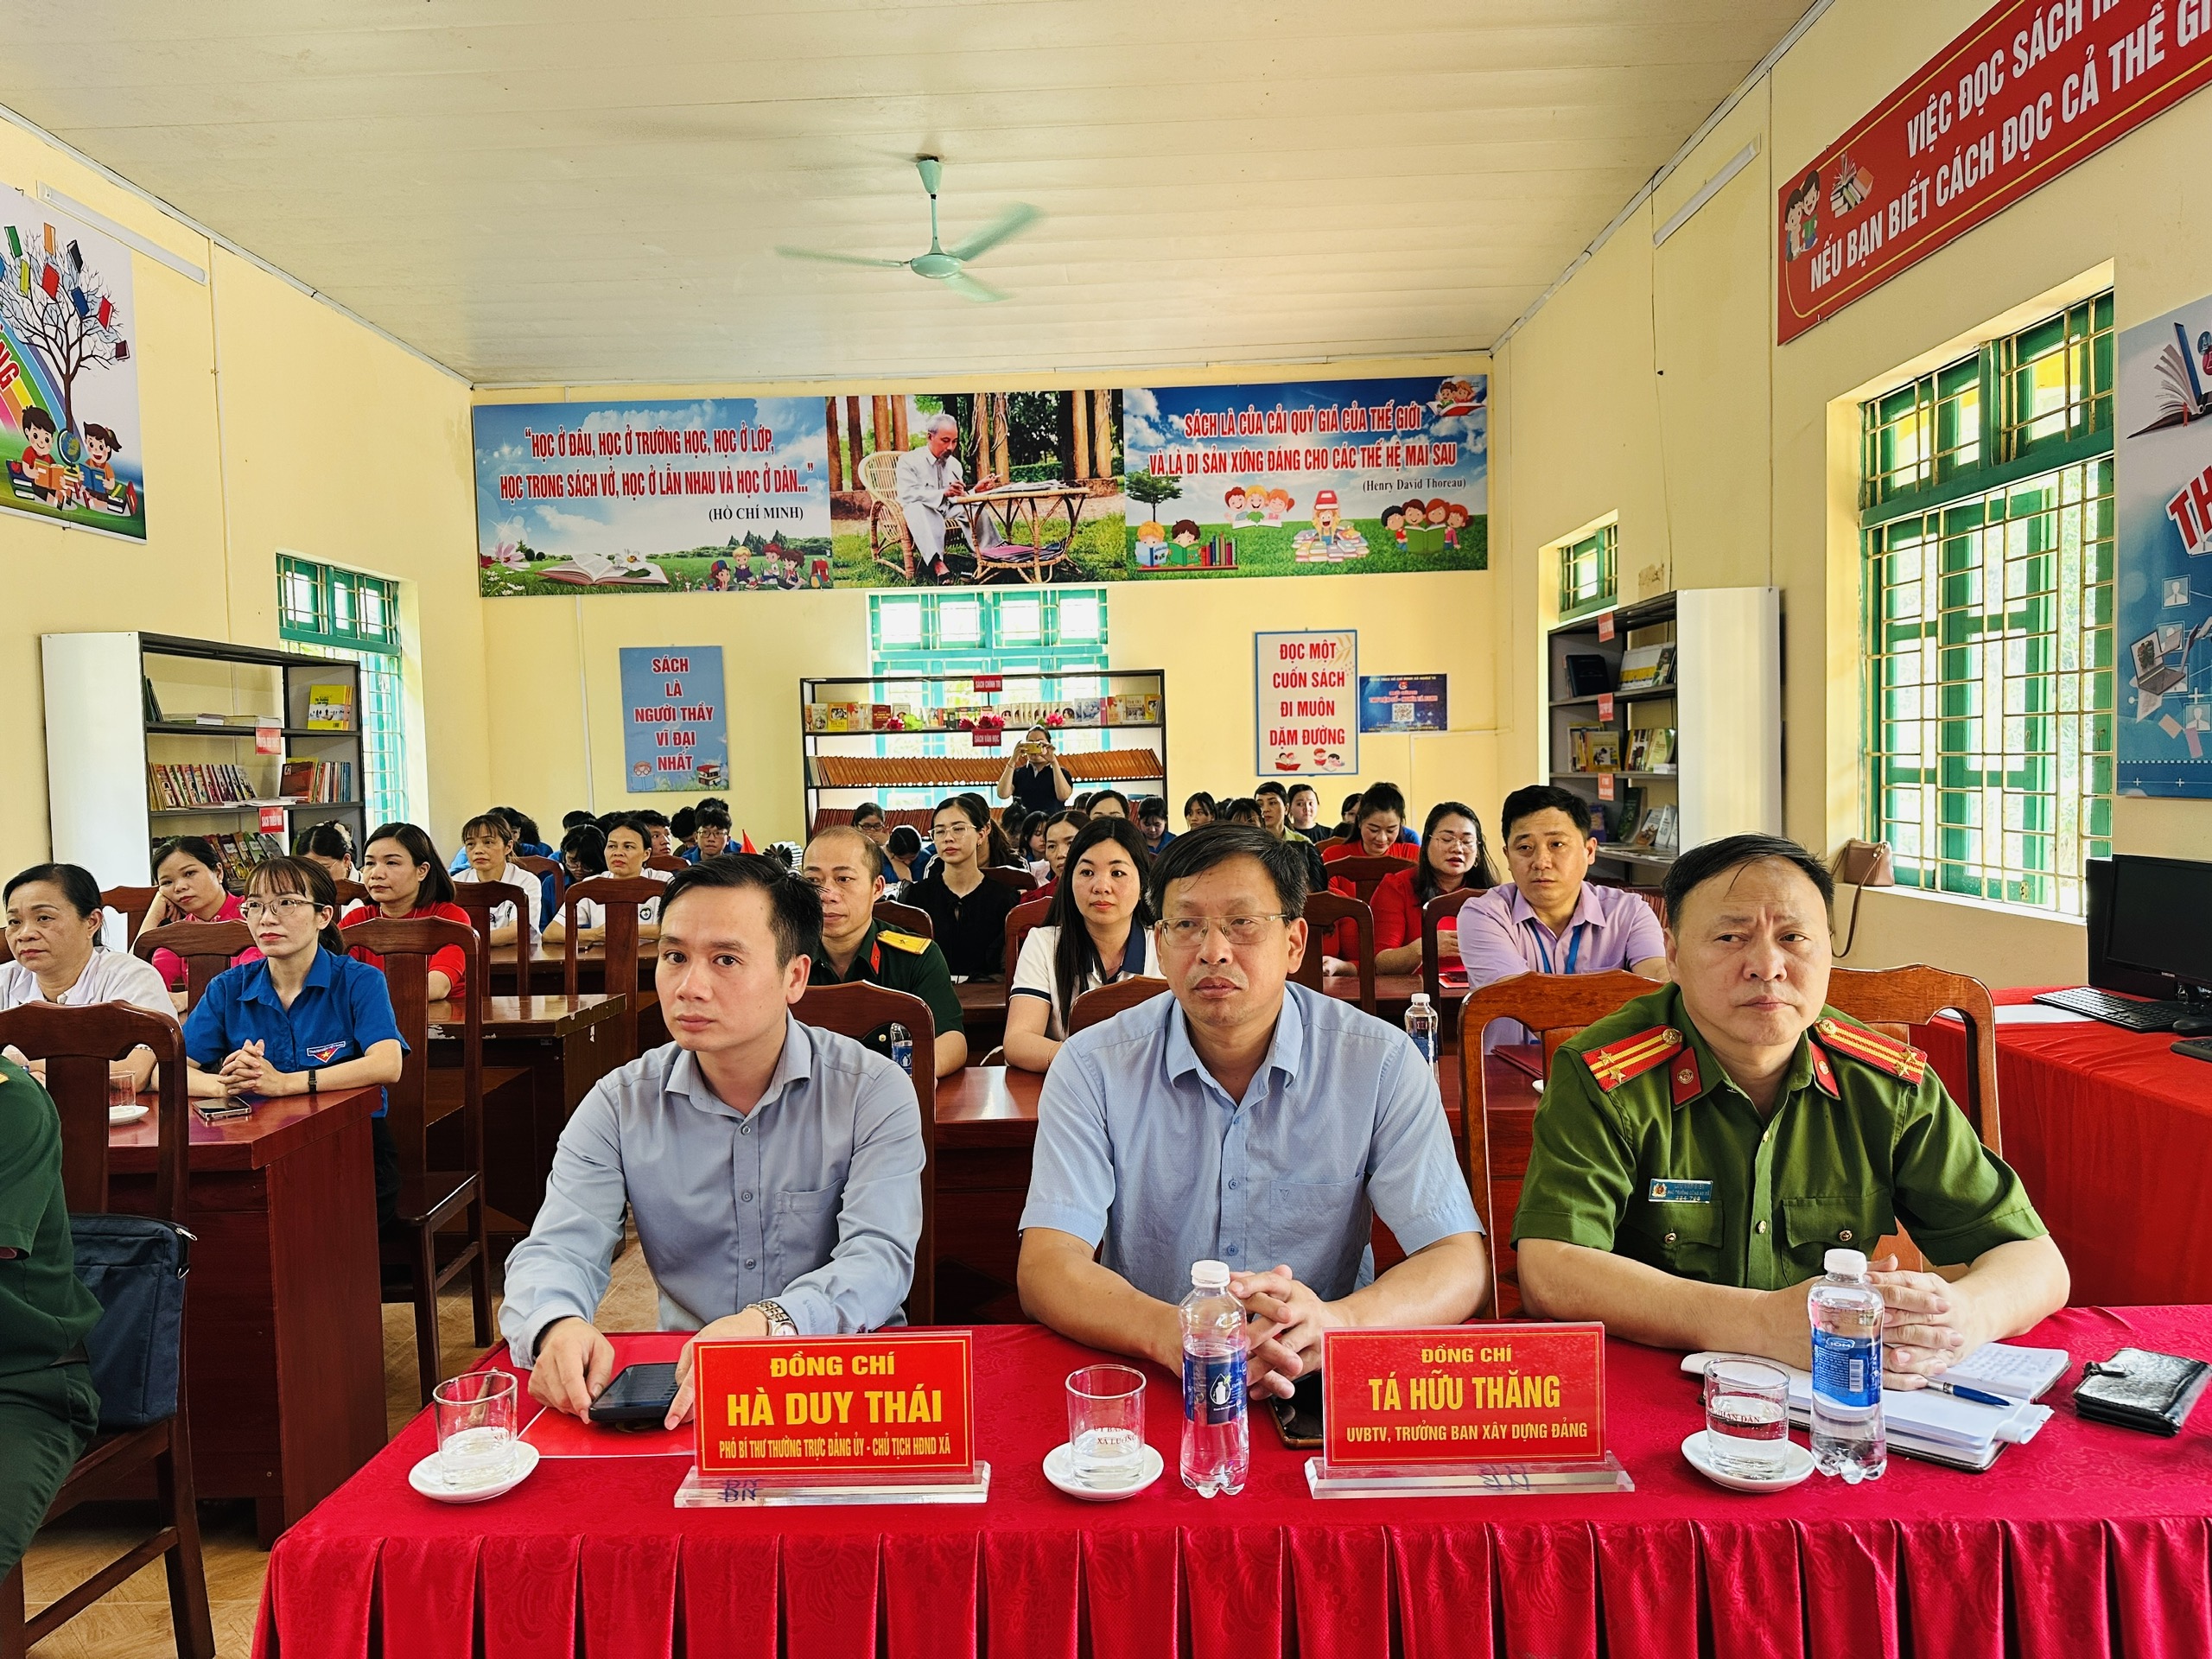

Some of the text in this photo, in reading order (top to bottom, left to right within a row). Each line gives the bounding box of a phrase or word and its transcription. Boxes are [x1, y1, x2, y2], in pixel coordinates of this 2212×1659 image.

[1907, 0, 2082, 158] VIỆC ĐỌC SÁCH
[1810, 233, 1842, 292] NẾU
[1847, 210, 1883, 268] BẠN
[1888, 170, 1930, 240] BIẾT
[1936, 130, 1994, 207] CÁCH
[2002, 92, 2053, 162] ĐỌC
[2062, 43, 2100, 124] CẢ
[1185, 399, 1421, 437] SÁCH LÀ CỦA CẢI QUÝ GIÁ CỦA THẾ GIỚI
[558, 424, 566, 456] Ở
[569, 429, 595, 459] ĐÂU,
[599, 432, 621, 461] HỌC
[625, 424, 632, 455] Ở
[635, 425, 681, 455] TRƯỜNG
[684, 430, 711, 459] HỌC,
[714, 429, 737, 458] HỌC
[741, 422, 747, 453] Ở
[751, 424, 774, 454] LỚP,
[1149, 439, 1456, 475] VÀ LÀ DI SẢN XỨNG ĐÁNG CHO CÁC THẾ HỆ MAI SAU
[500, 475, 524, 504] HỌC
[526, 474, 564, 499] TRONG
[567, 469, 598, 498] SÁCH
[601, 465, 620, 499] VỞ,
[622, 473, 645, 501] HỌC
[649, 464, 656, 495] Ở
[659, 463, 682, 495] LẪN
[684, 471, 715, 495] NHAU
[719, 466, 734, 494] VÀ
[737, 470, 760, 499] HỌC
[763, 461, 771, 493] Ở
[1363, 478, 1466, 493] (Henry David Thoreau)
[709, 504, 804, 522] (HỒ CHÍ MINH)
[1280, 639, 1337, 663] ĐỌC MỘT
[652, 655, 689, 673] SÁCH
[665, 680, 683, 697] LÀ
[1273, 666, 1345, 689] CUỐN SÁCH
[634, 704, 677, 722] NGƯỜI
[1281, 696, 1335, 717] ĐI MUÔN
[656, 729, 696, 749] VĨ ĐẠI
[1269, 725, 1345, 749] DẶM ĐƯỜNG
[657, 751, 692, 771] NHẤT
[770, 1350, 895, 1377] ĐỒNG CHÍ
[1421, 1343, 1512, 1363] ĐỒNG CHÍ
[1368, 1370, 1560, 1411] TÁ HỮU THĂNG
[727, 1383, 942, 1427] HÀ DUY THÁI
[1346, 1417, 1588, 1444] UVBTV, TRƯỞNG BAN XÂY DỰNG ĐẢNG
[719, 1437, 737, 1459] PHÓ
[739, 1437, 747, 1459] BÍ
[749, 1438, 766, 1459] THƯ
[767, 1435, 802, 1459] THƯỜNG
[804, 1437, 826, 1461] TRỰC
[828, 1432, 851, 1457] ĐẢNG
[854, 1432, 865, 1457] ỦY
[873, 1432, 890, 1457] CHỦ
[892, 1437, 912, 1460] TỊCH
[913, 1437, 937, 1456] HĐND
[938, 1433, 951, 1455] XÃ
